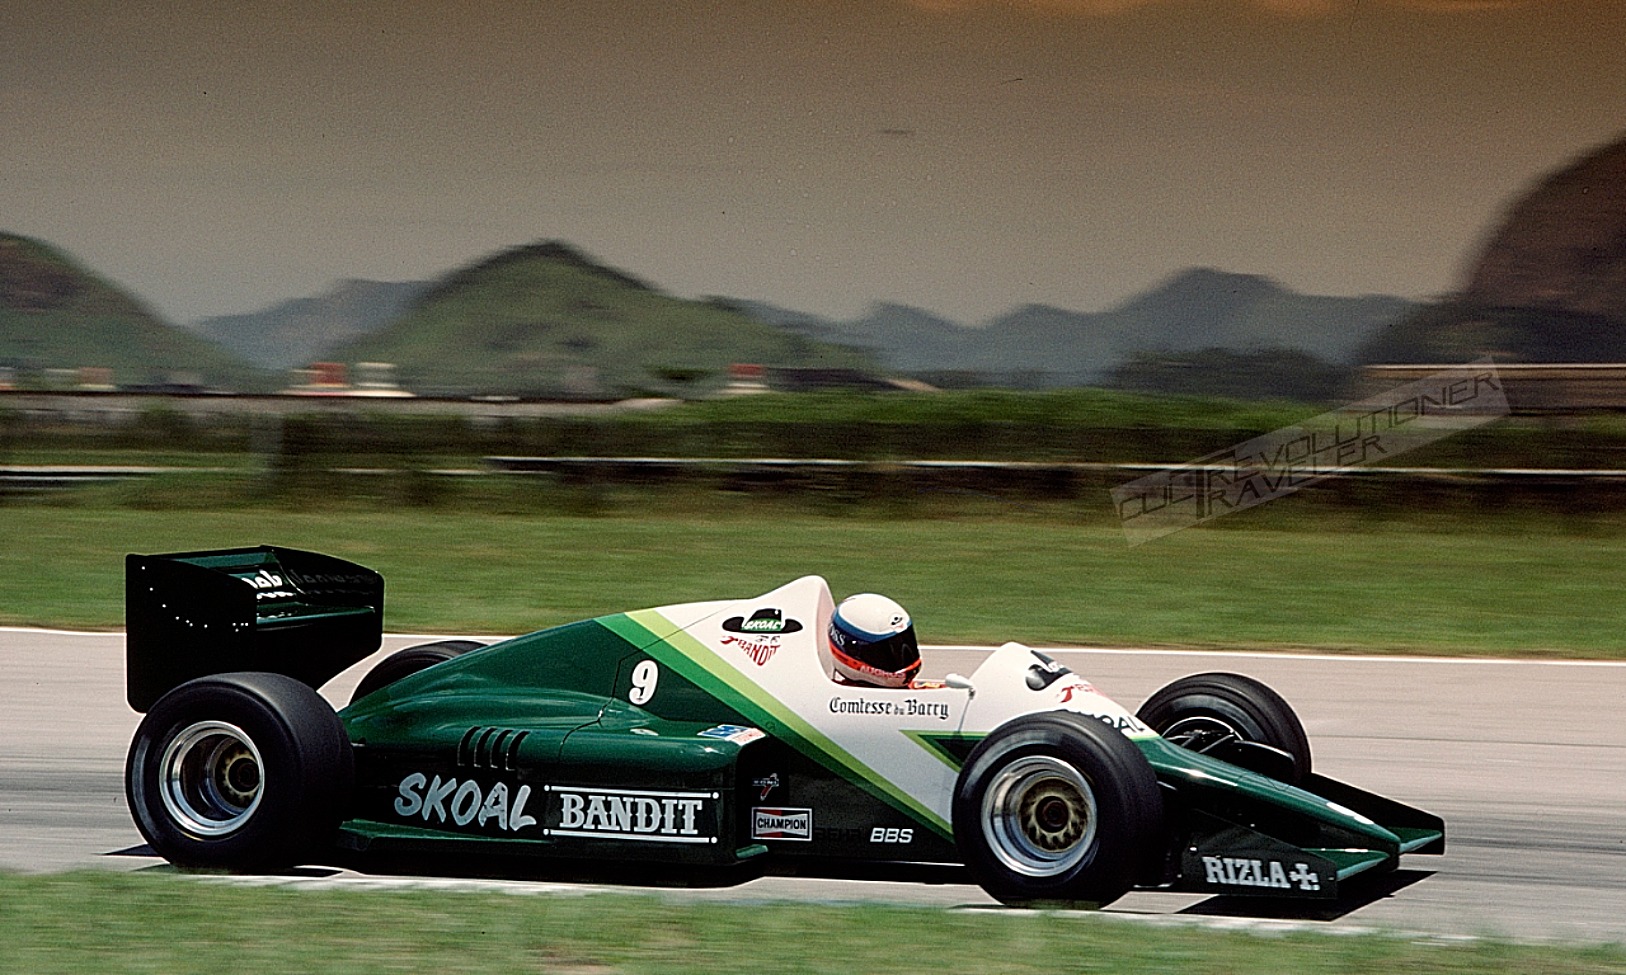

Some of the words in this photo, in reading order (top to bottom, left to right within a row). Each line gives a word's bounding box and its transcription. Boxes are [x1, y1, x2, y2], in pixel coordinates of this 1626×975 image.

[629, 659, 659, 705] 9
[829, 697, 892, 715] Comtesse
[907, 698, 949, 720] Barry
[394, 772, 537, 832] SKOAL
[559, 793, 703, 835] BANDIT
[756, 816, 807, 831] CHAMPION
[869, 827, 914, 844] BBS
